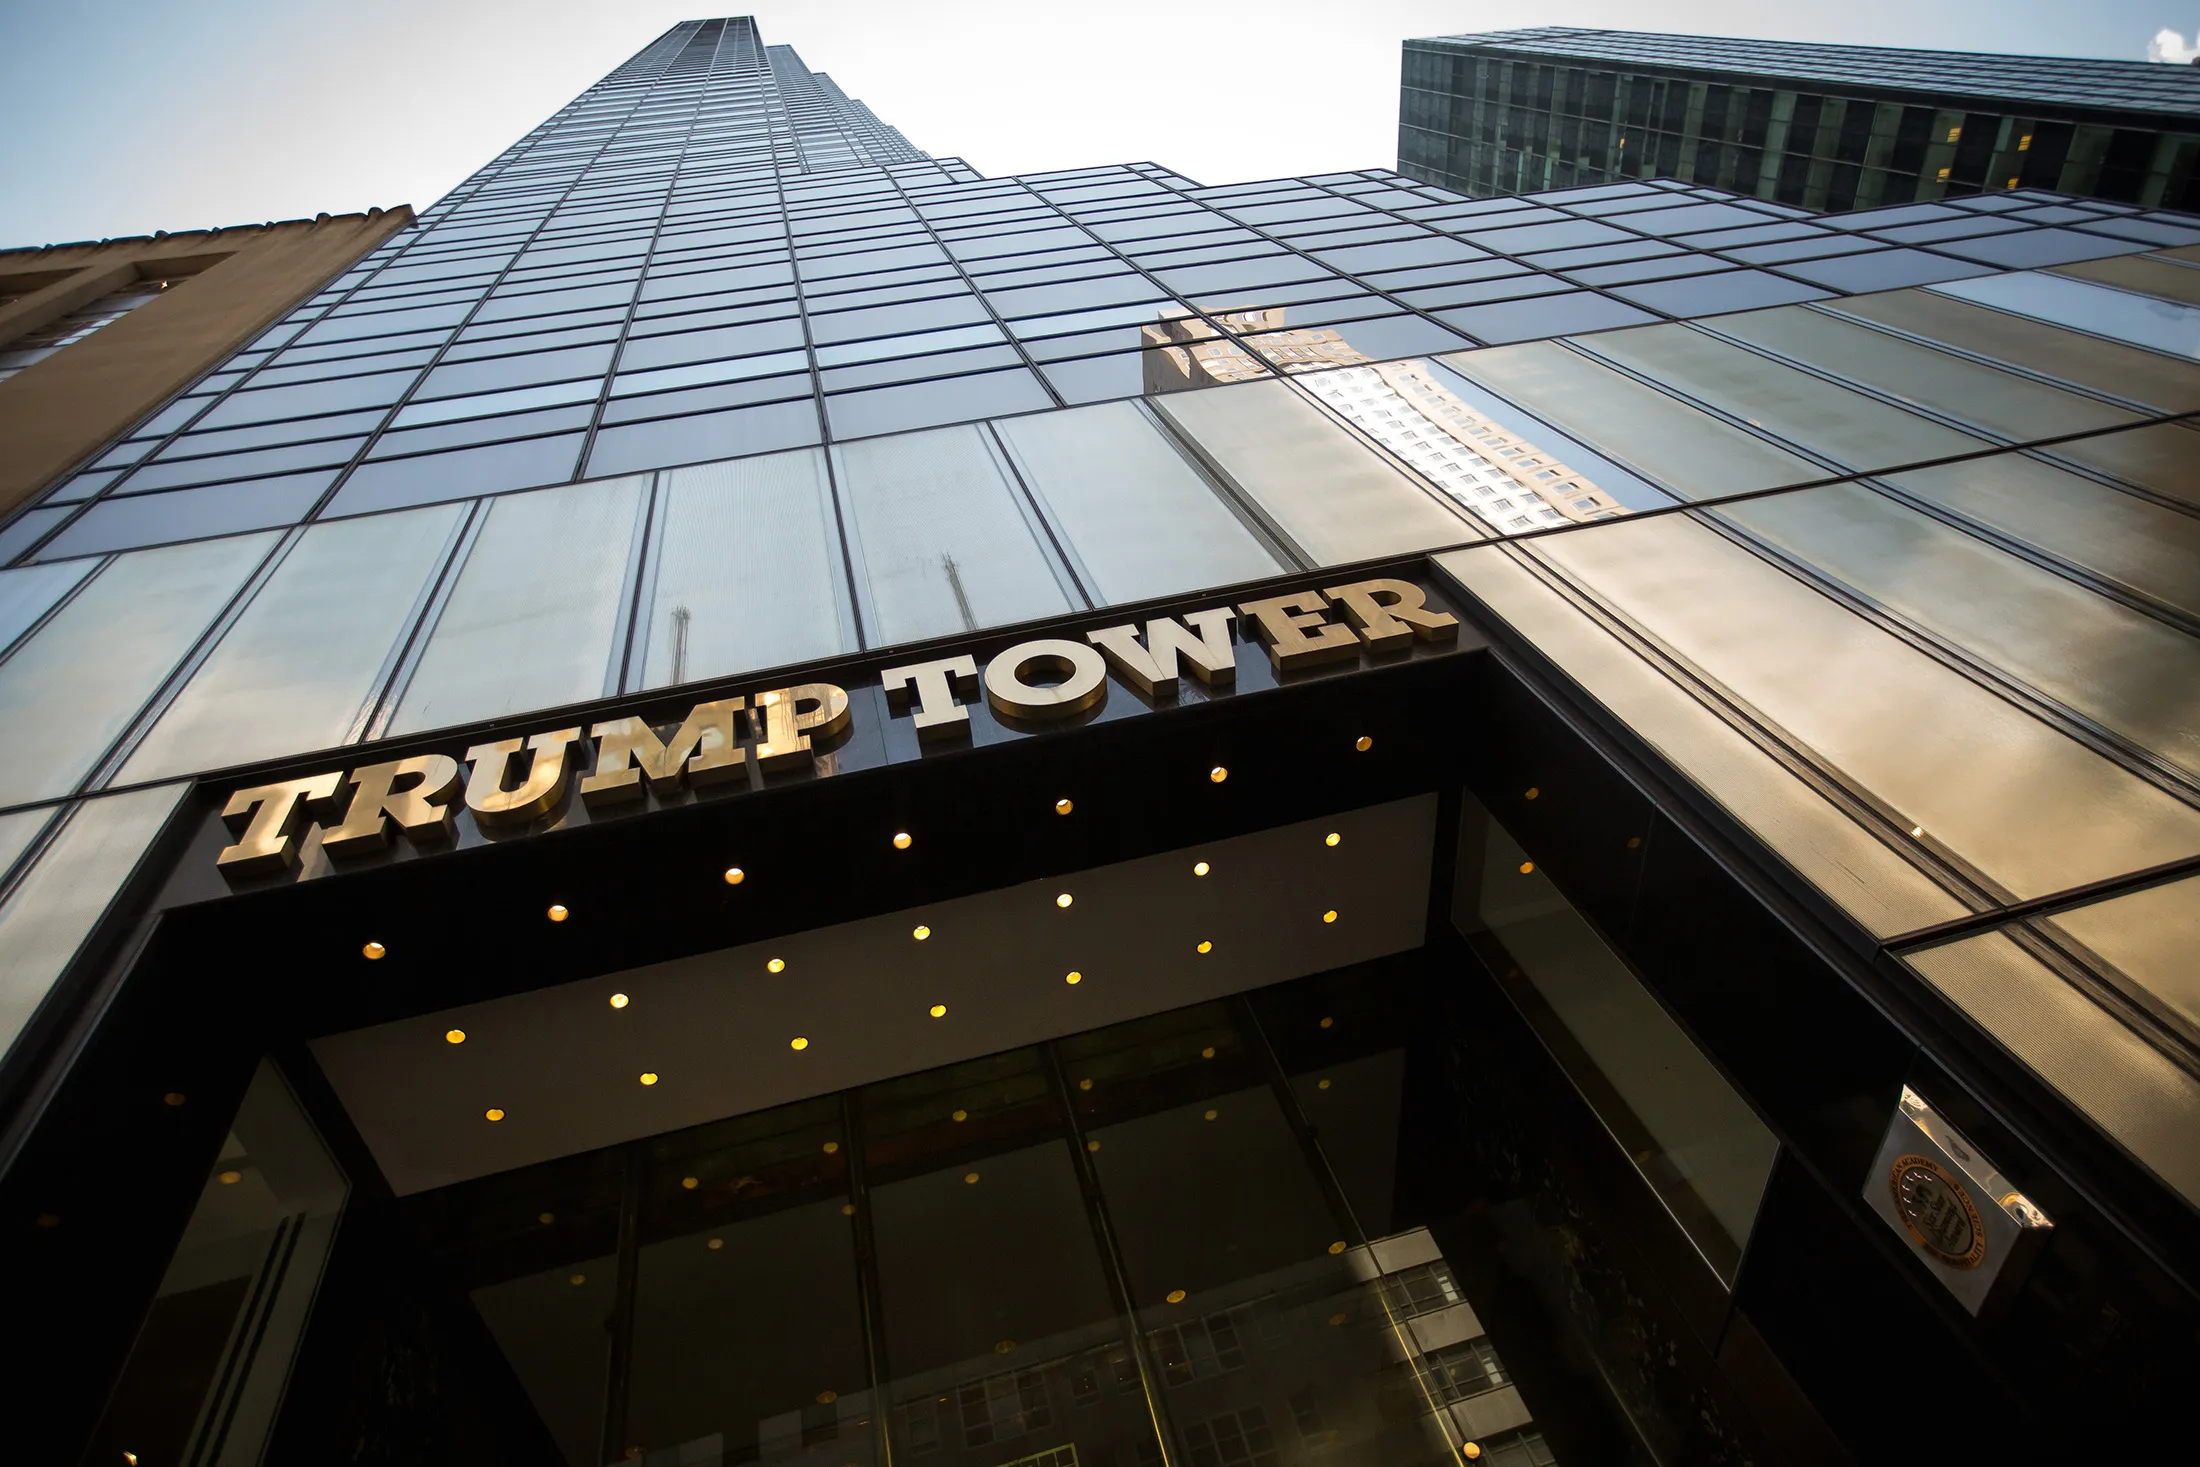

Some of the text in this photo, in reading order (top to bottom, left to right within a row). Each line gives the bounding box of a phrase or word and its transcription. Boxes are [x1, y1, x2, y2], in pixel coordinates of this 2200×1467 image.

[216, 578, 1460, 876] TRUMP TOWER
[1902, 1157, 1938, 1172] ACADEMY
[1952, 1182, 1983, 1239] SCIENCES
